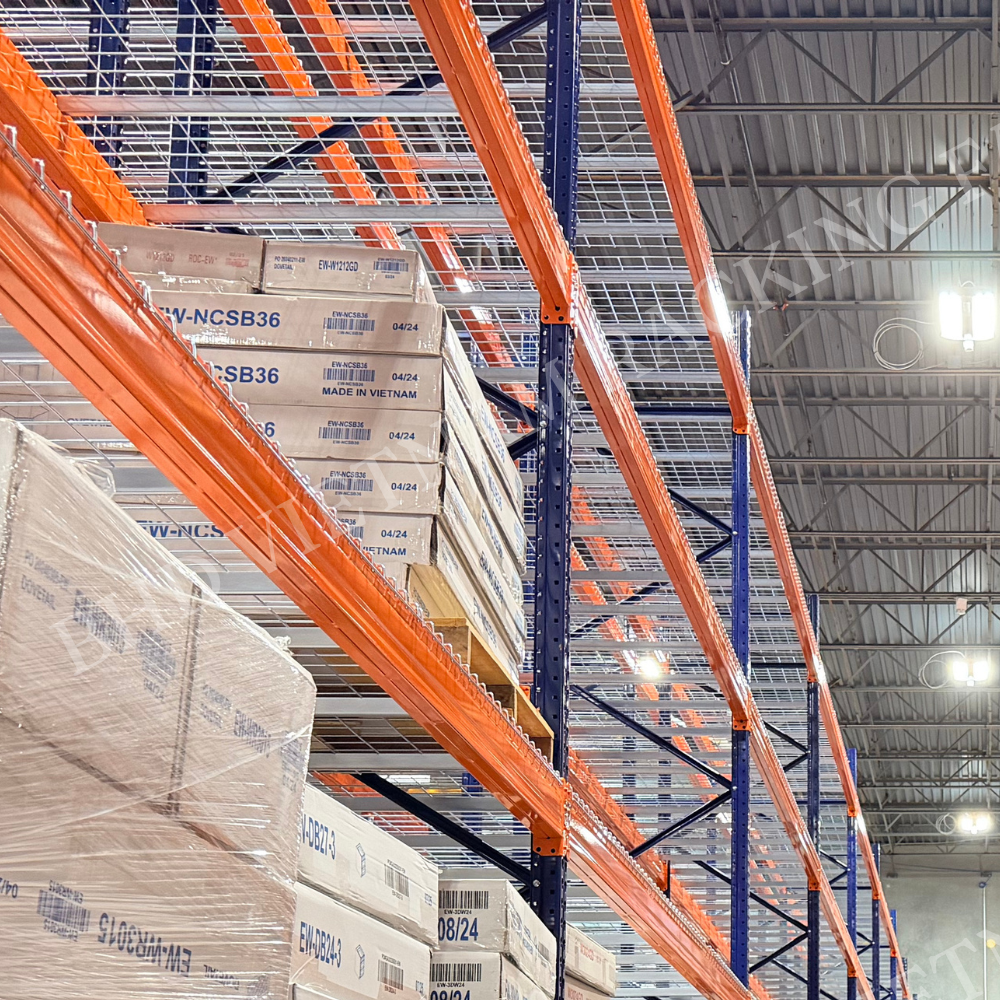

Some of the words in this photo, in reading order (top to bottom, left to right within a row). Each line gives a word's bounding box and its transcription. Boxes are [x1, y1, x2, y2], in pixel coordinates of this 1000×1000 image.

[318, 259, 358, 272] EW-W1212GD
[392, 322, 418, 331] 04/24
[332, 361, 367, 369] EW-NCSB36
[392, 373, 418, 381] 04/24
[322, 387, 353, 396] MADE
[356, 388, 366, 397] IN
[370, 389, 417, 399] VIETNAM
[327, 420, 364, 428] EW-NCSB36
[389, 431, 415, 440] 04/24
[330, 471, 366, 479] EW-NCSB36
[391, 482, 417, 491] 04/24
[381, 530, 407, 539] 04/24
[438, 917, 478, 941] 08/24
[97, 911, 192, 978] EW-WR3015
